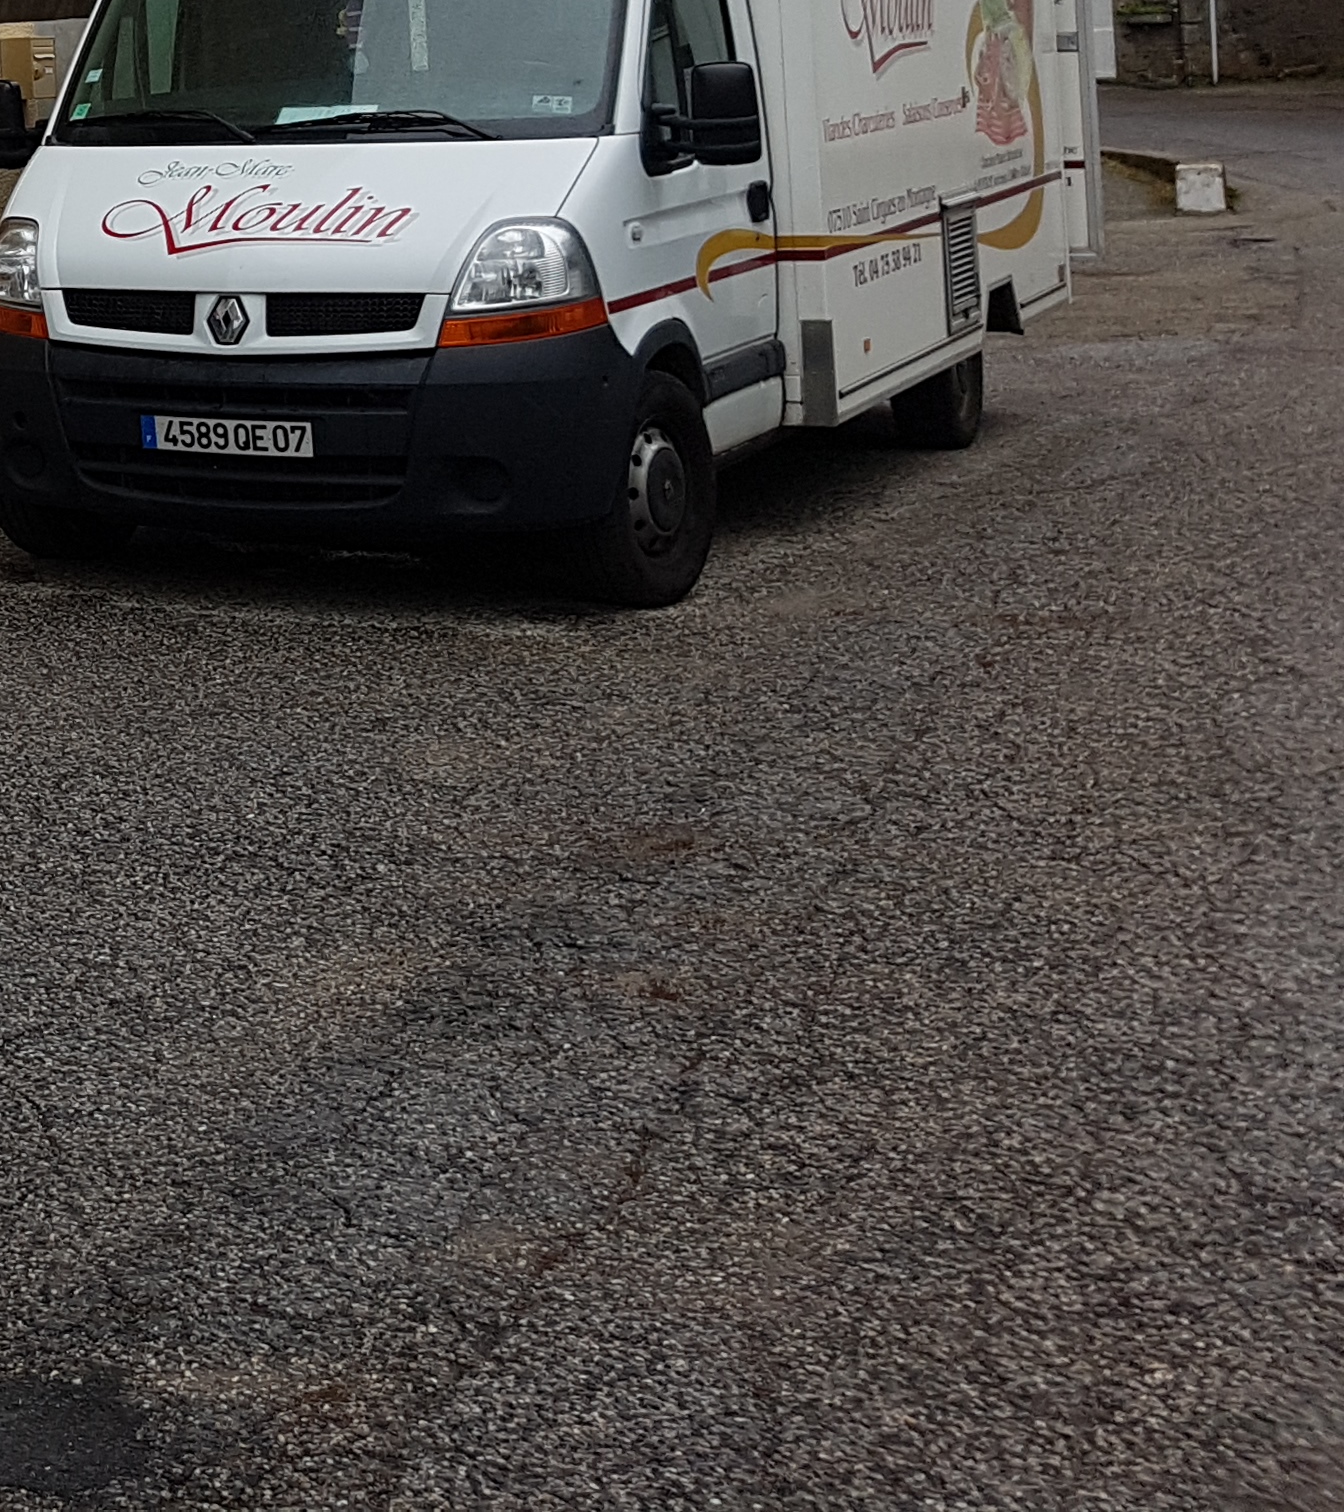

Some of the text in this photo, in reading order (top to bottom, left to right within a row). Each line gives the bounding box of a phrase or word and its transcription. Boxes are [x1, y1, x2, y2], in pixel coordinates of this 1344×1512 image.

[101, 184, 416, 257] Moulin
[164, 420, 307, 453] 4589 QE 07
